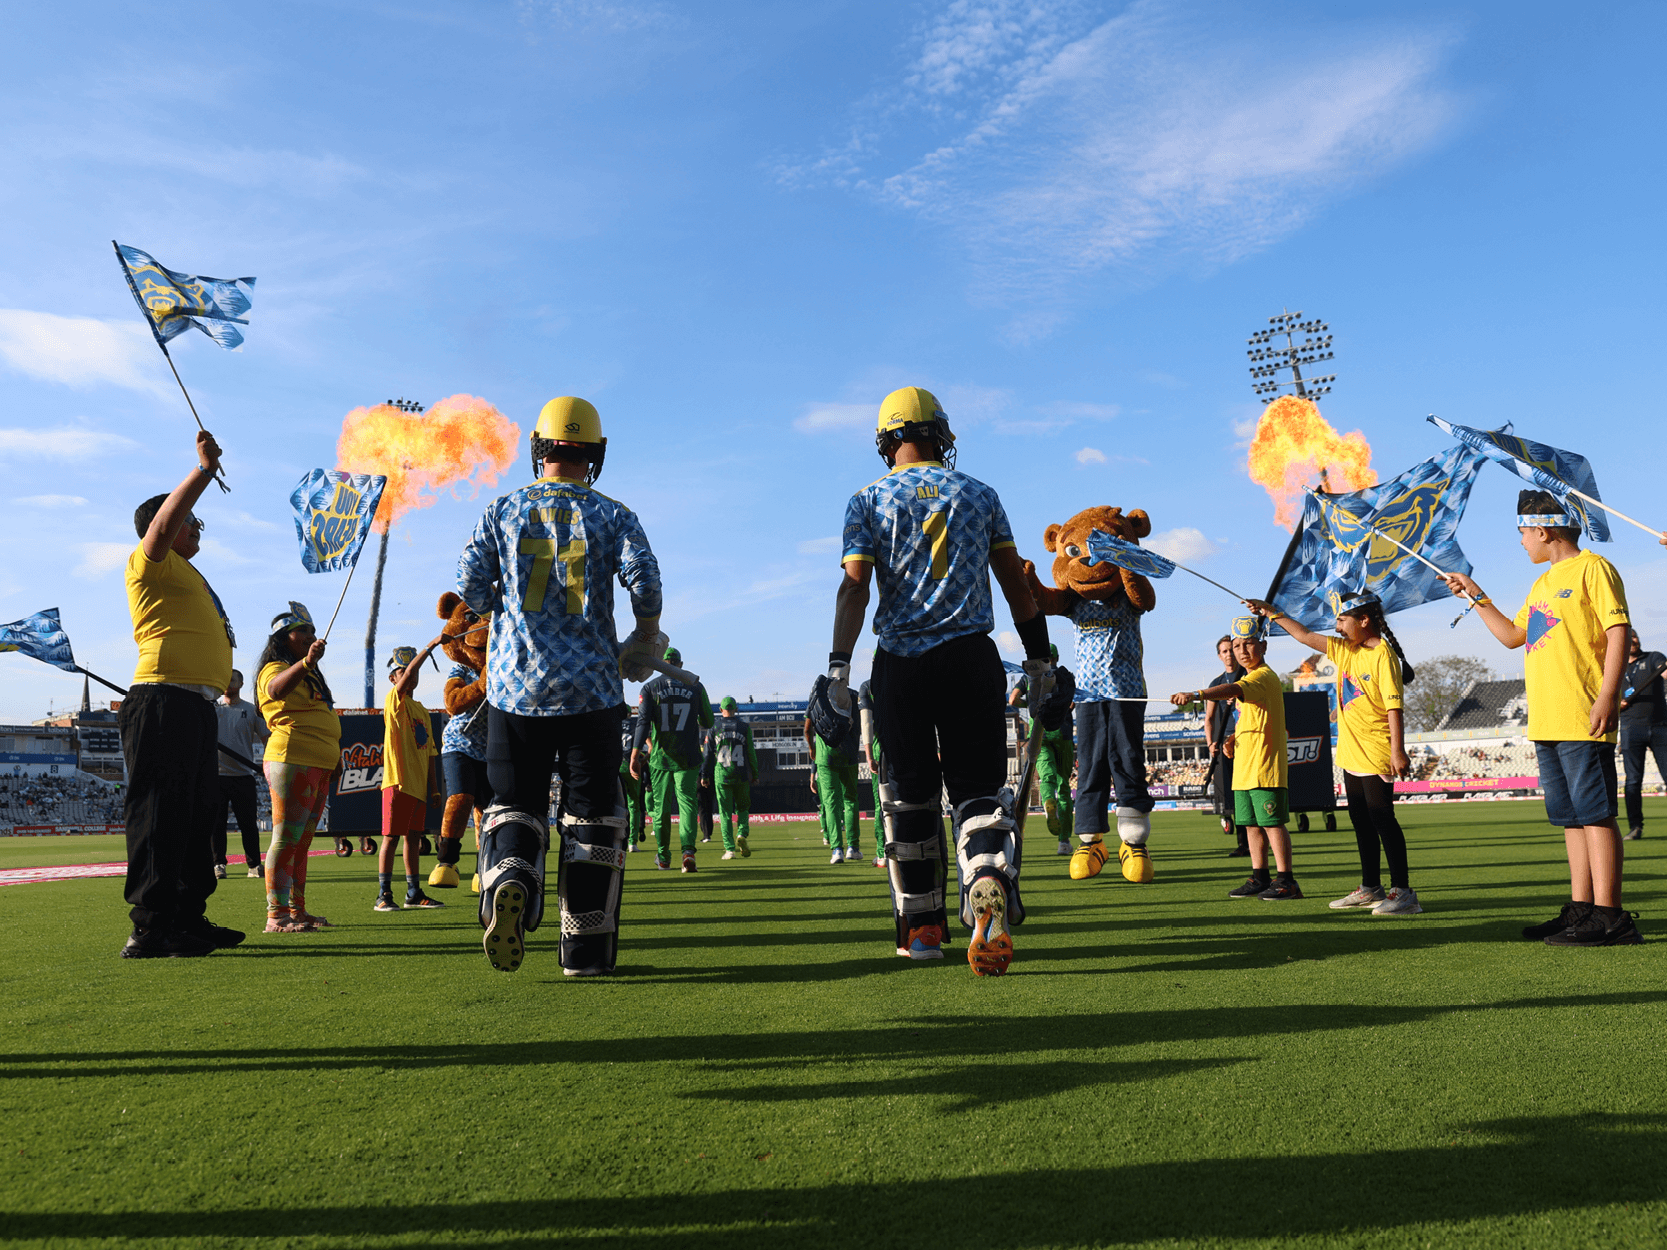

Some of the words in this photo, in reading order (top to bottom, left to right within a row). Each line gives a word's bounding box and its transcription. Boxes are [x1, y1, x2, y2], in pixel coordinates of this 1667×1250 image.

[916, 485, 939, 499] ALI
[529, 508, 580, 525] DAVIES
[922, 511, 949, 580] 1
[519, 538, 586, 615] 71
[1079, 617, 1120, 630] talbots
[660, 703, 691, 732] 17
